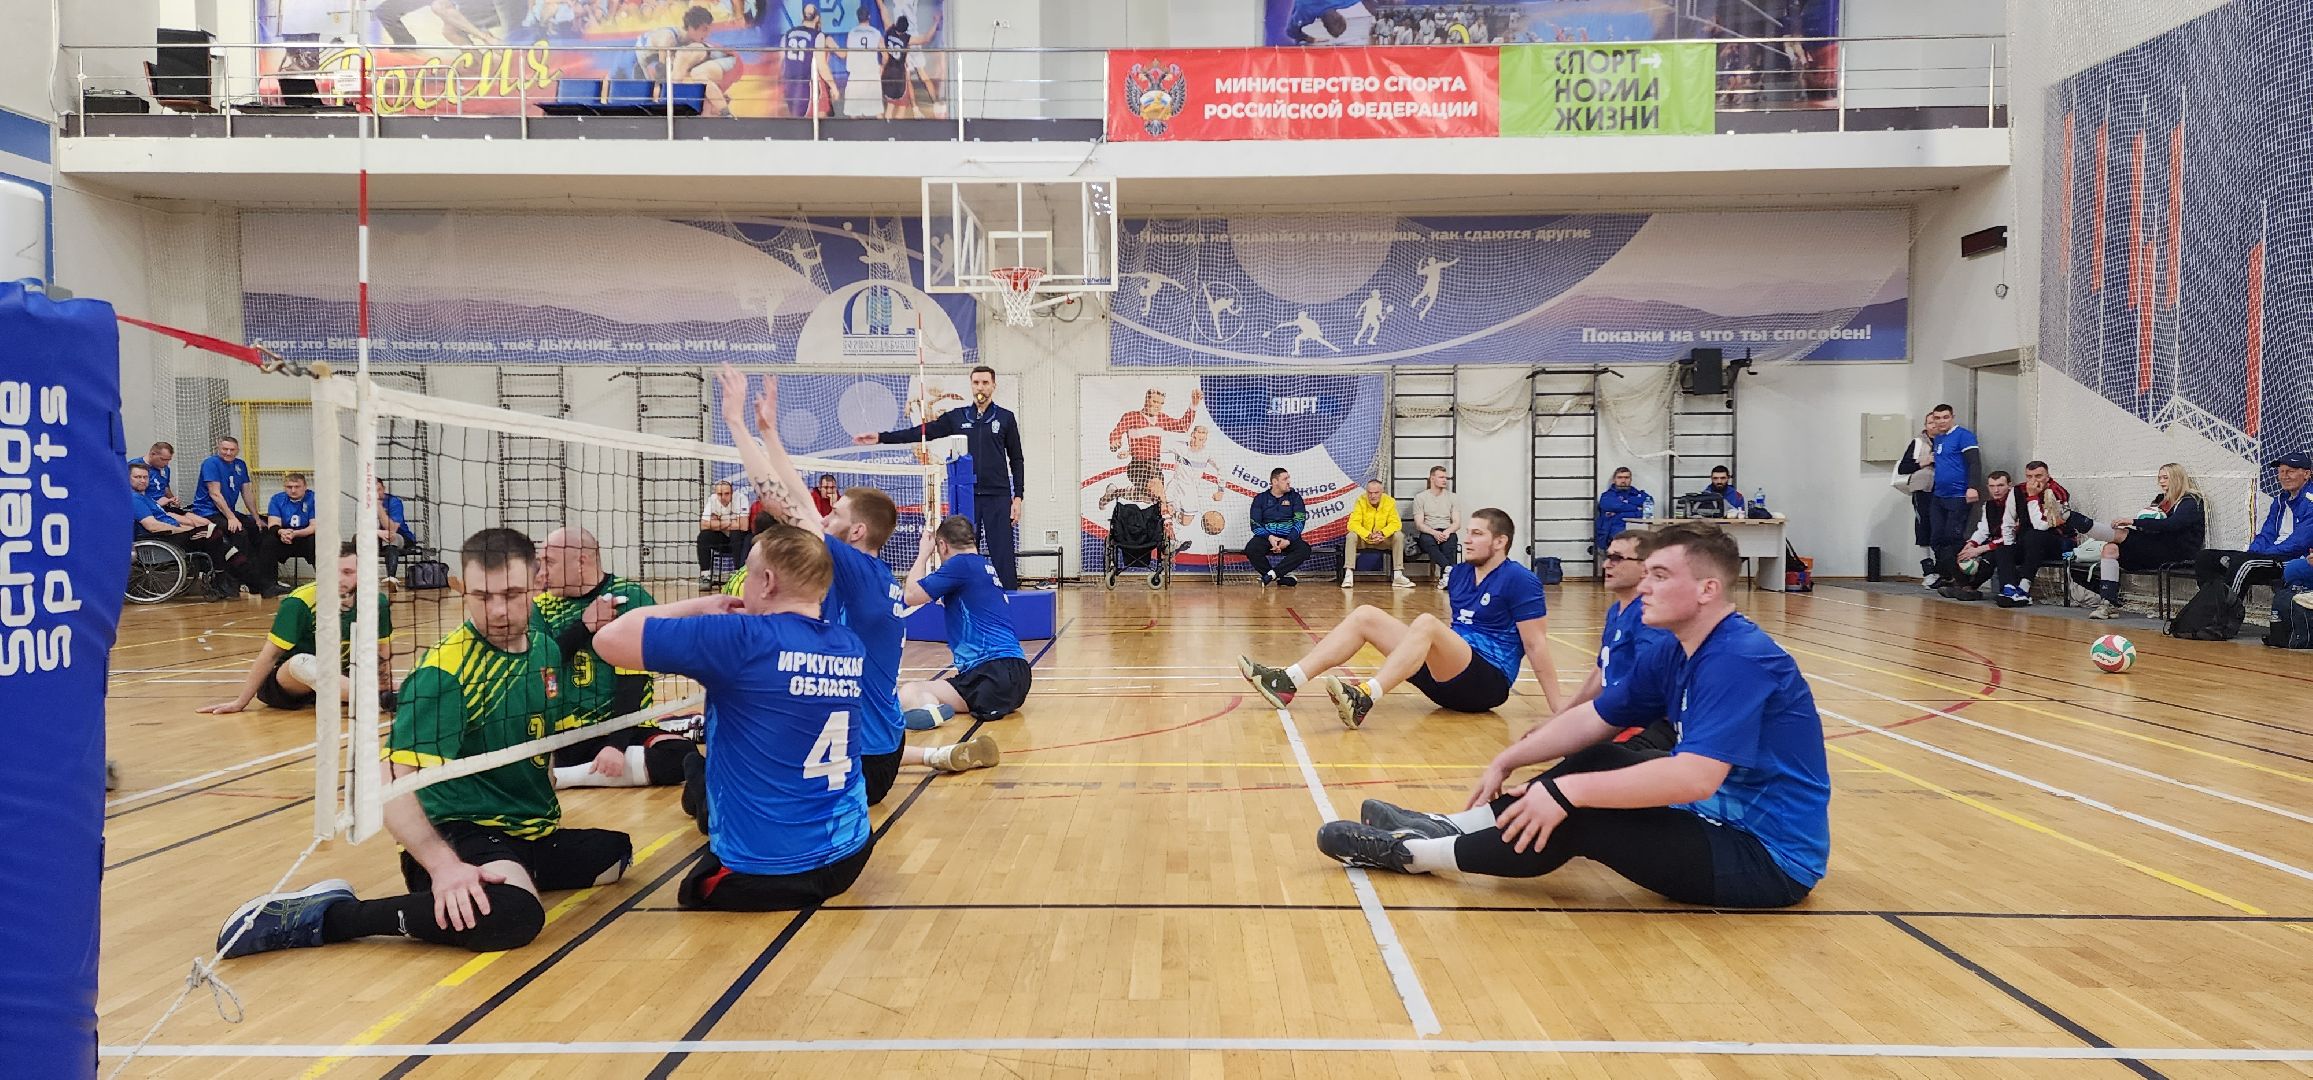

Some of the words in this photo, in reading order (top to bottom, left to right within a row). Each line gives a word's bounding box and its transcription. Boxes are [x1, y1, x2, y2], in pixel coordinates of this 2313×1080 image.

[1555, 49, 1641, 74] СПОРТ
[1215, 76, 1380, 93] МИНИСТЕРСТВО
[1384, 76, 1467, 92] СПОРТА
[1555, 77, 1659, 102] НОРМА
[1204, 98, 1343, 119] РОССИЙСКОЙ
[1347, 100, 1478, 120] ФЕДЕРАЦИИ
[1554, 105, 1659, 131] ЖИЗНИ
[1139, 231, 1204, 245] Никогда
[1210, 233, 1229, 243] не
[1431, 230, 1460, 241] как
[1464, 229, 1531, 242] сдаются
[1535, 227, 1591, 242] другие
[300, 340, 325, 350] это
[327, 337, 387, 350] БИЕИЕ
[391, 340, 438, 350] твоего
[620, 341, 643, 351] это
[649, 339, 680, 351] твой
[685, 339, 726, 351] РИТМ
[729, 341, 776, 351] жизни
[1582, 327, 1665, 343] Покажи
[1670, 330, 1694, 342] на
[1700, 329, 1734, 342] что
[1740, 328, 1768, 342] ты
[1773, 324, 1872, 343] способен!
[1268, 396, 1318, 414] СПОРТ
[573, 649, 594, 687] 9
[789, 675, 862, 698] ОБЛАСТЬ
[803, 711, 852, 791] 4
